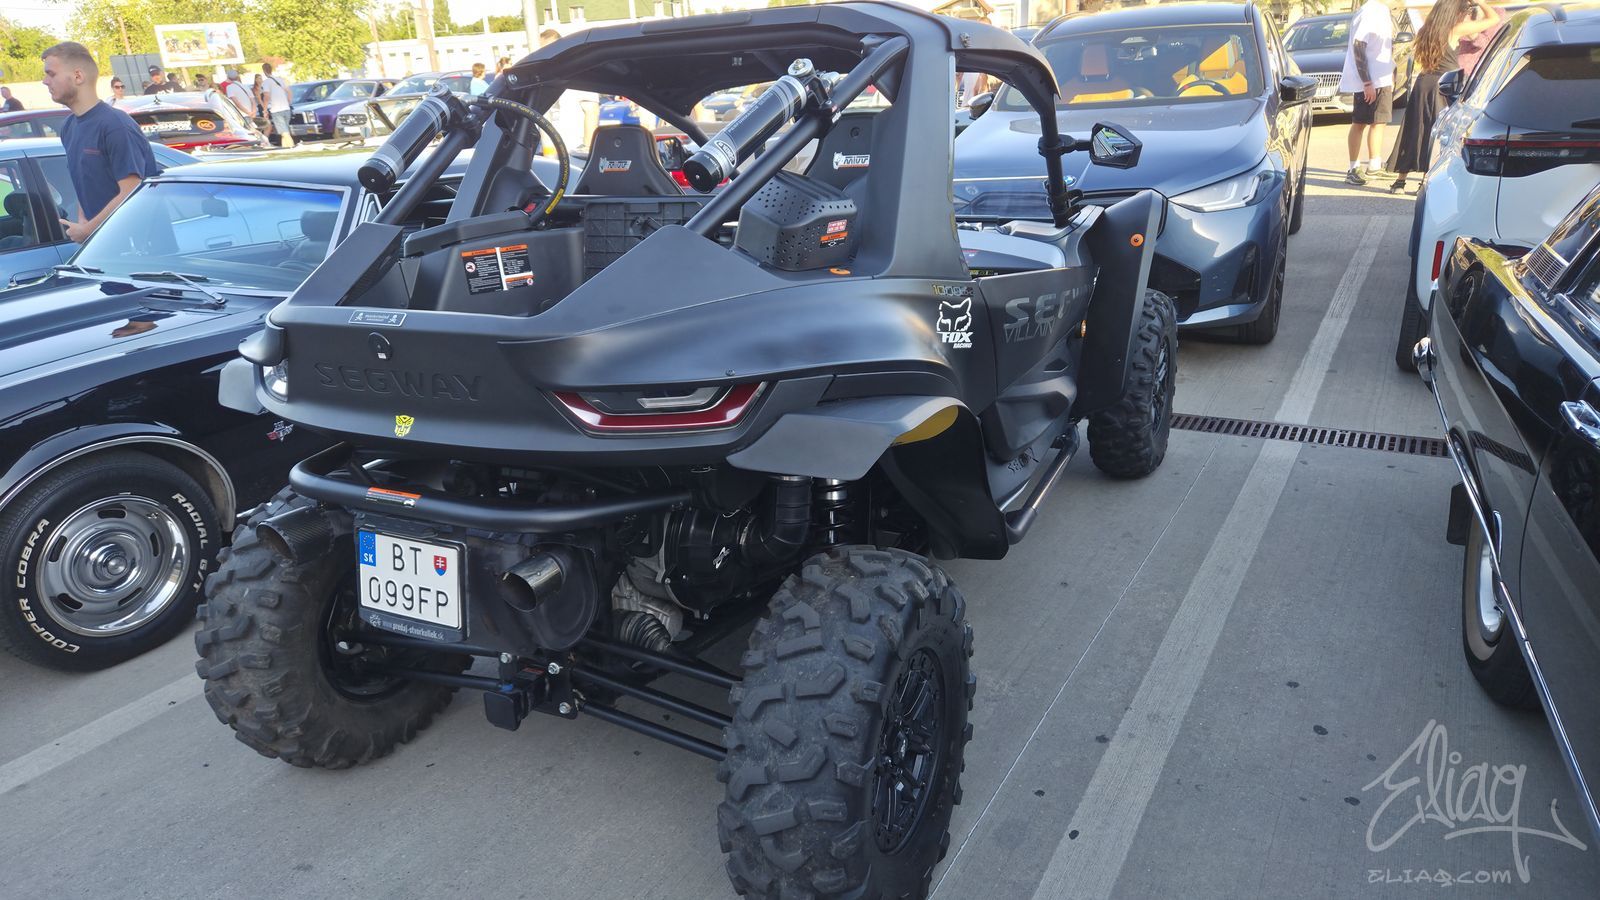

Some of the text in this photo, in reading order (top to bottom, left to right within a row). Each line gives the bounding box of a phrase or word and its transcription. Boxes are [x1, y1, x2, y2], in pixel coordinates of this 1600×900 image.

[937, 331, 973, 343] FOX
[1004, 320, 1056, 343] VILLAIN
[314, 362, 482, 402] SEGWAY
[171, 492, 209, 594] RADIAL G/T
[363, 552, 374, 563] SK
[392, 543, 422, 576] BT
[16, 518, 81, 654] COOPER COBRA
[369, 576, 449, 618] 099FP
